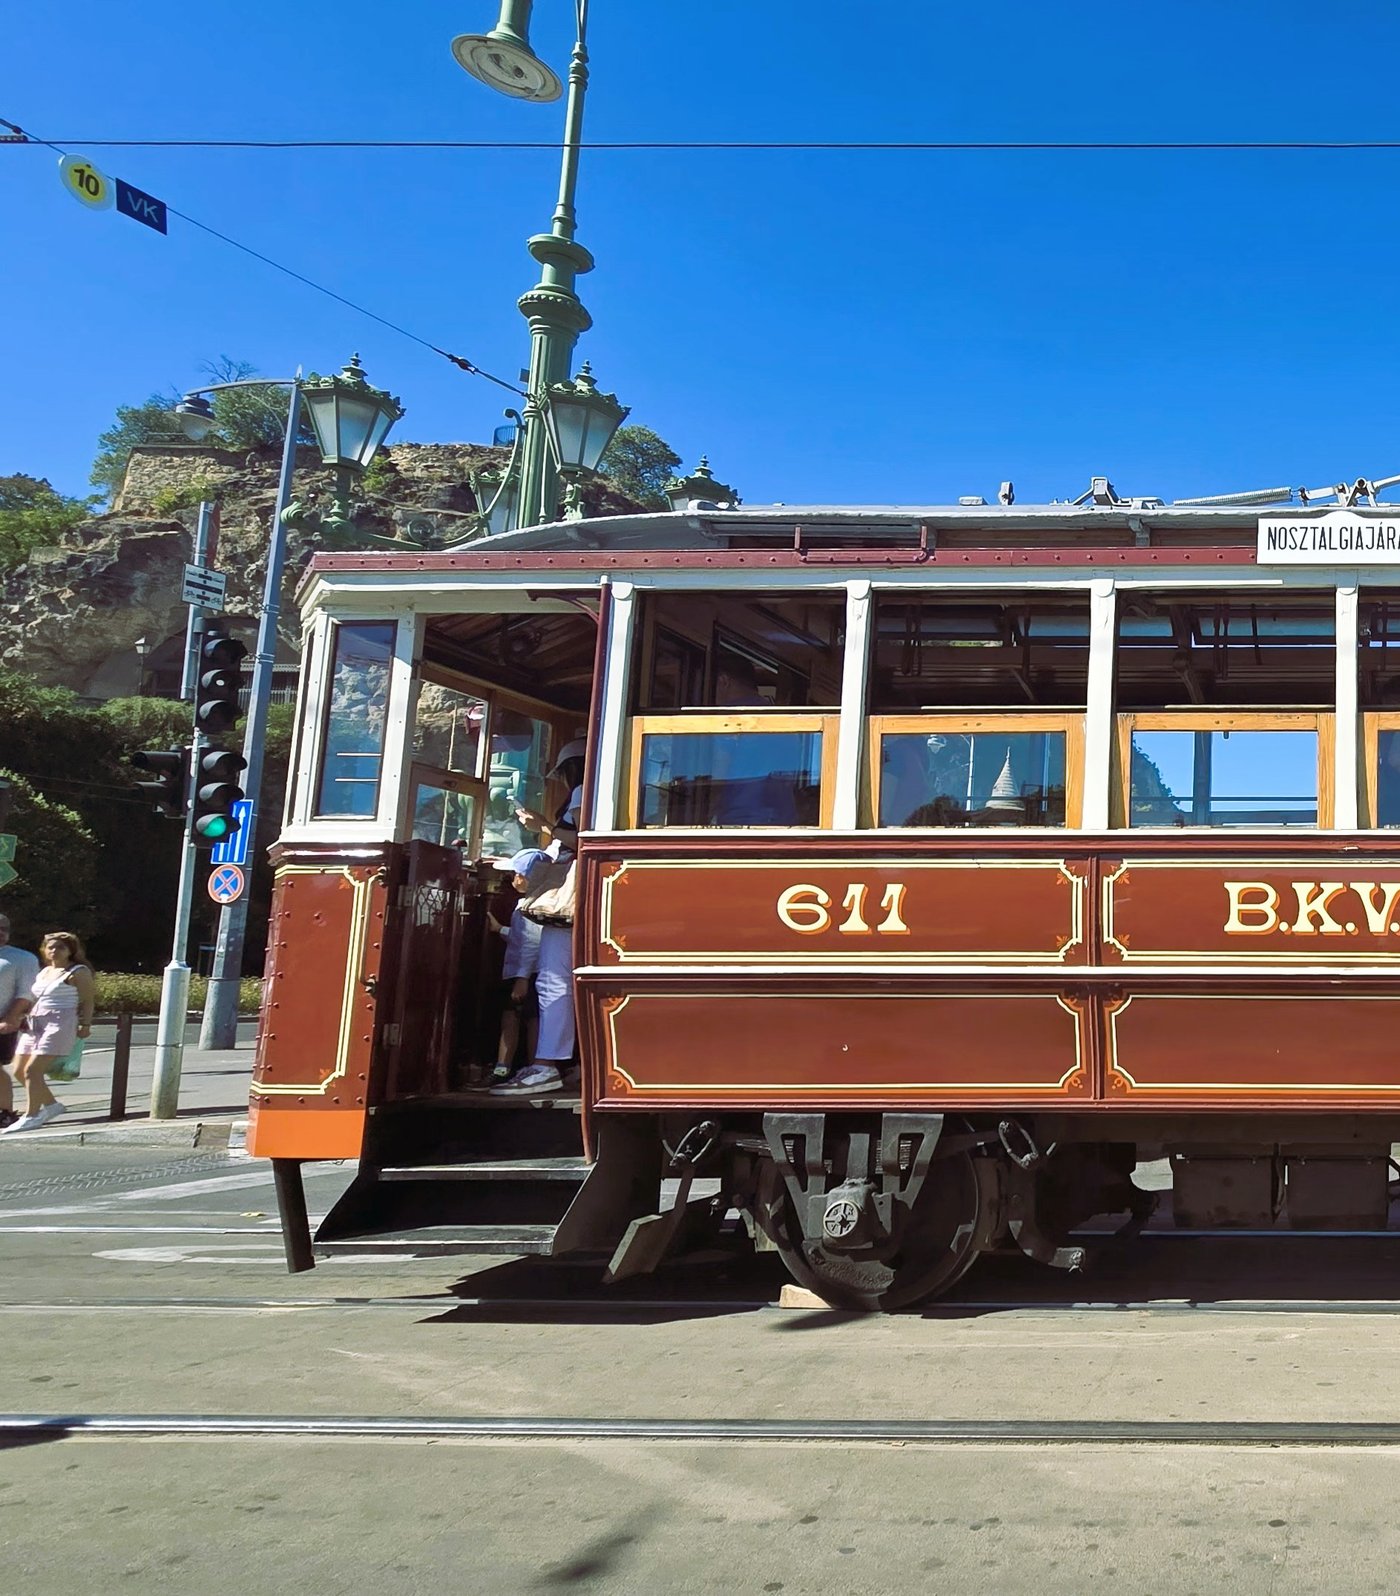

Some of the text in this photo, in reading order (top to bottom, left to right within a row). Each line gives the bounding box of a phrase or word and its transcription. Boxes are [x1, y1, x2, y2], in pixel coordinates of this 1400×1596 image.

[73, 168, 100, 196] 10
[127, 191, 158, 223] VK
[776, 882, 911, 936] 611
